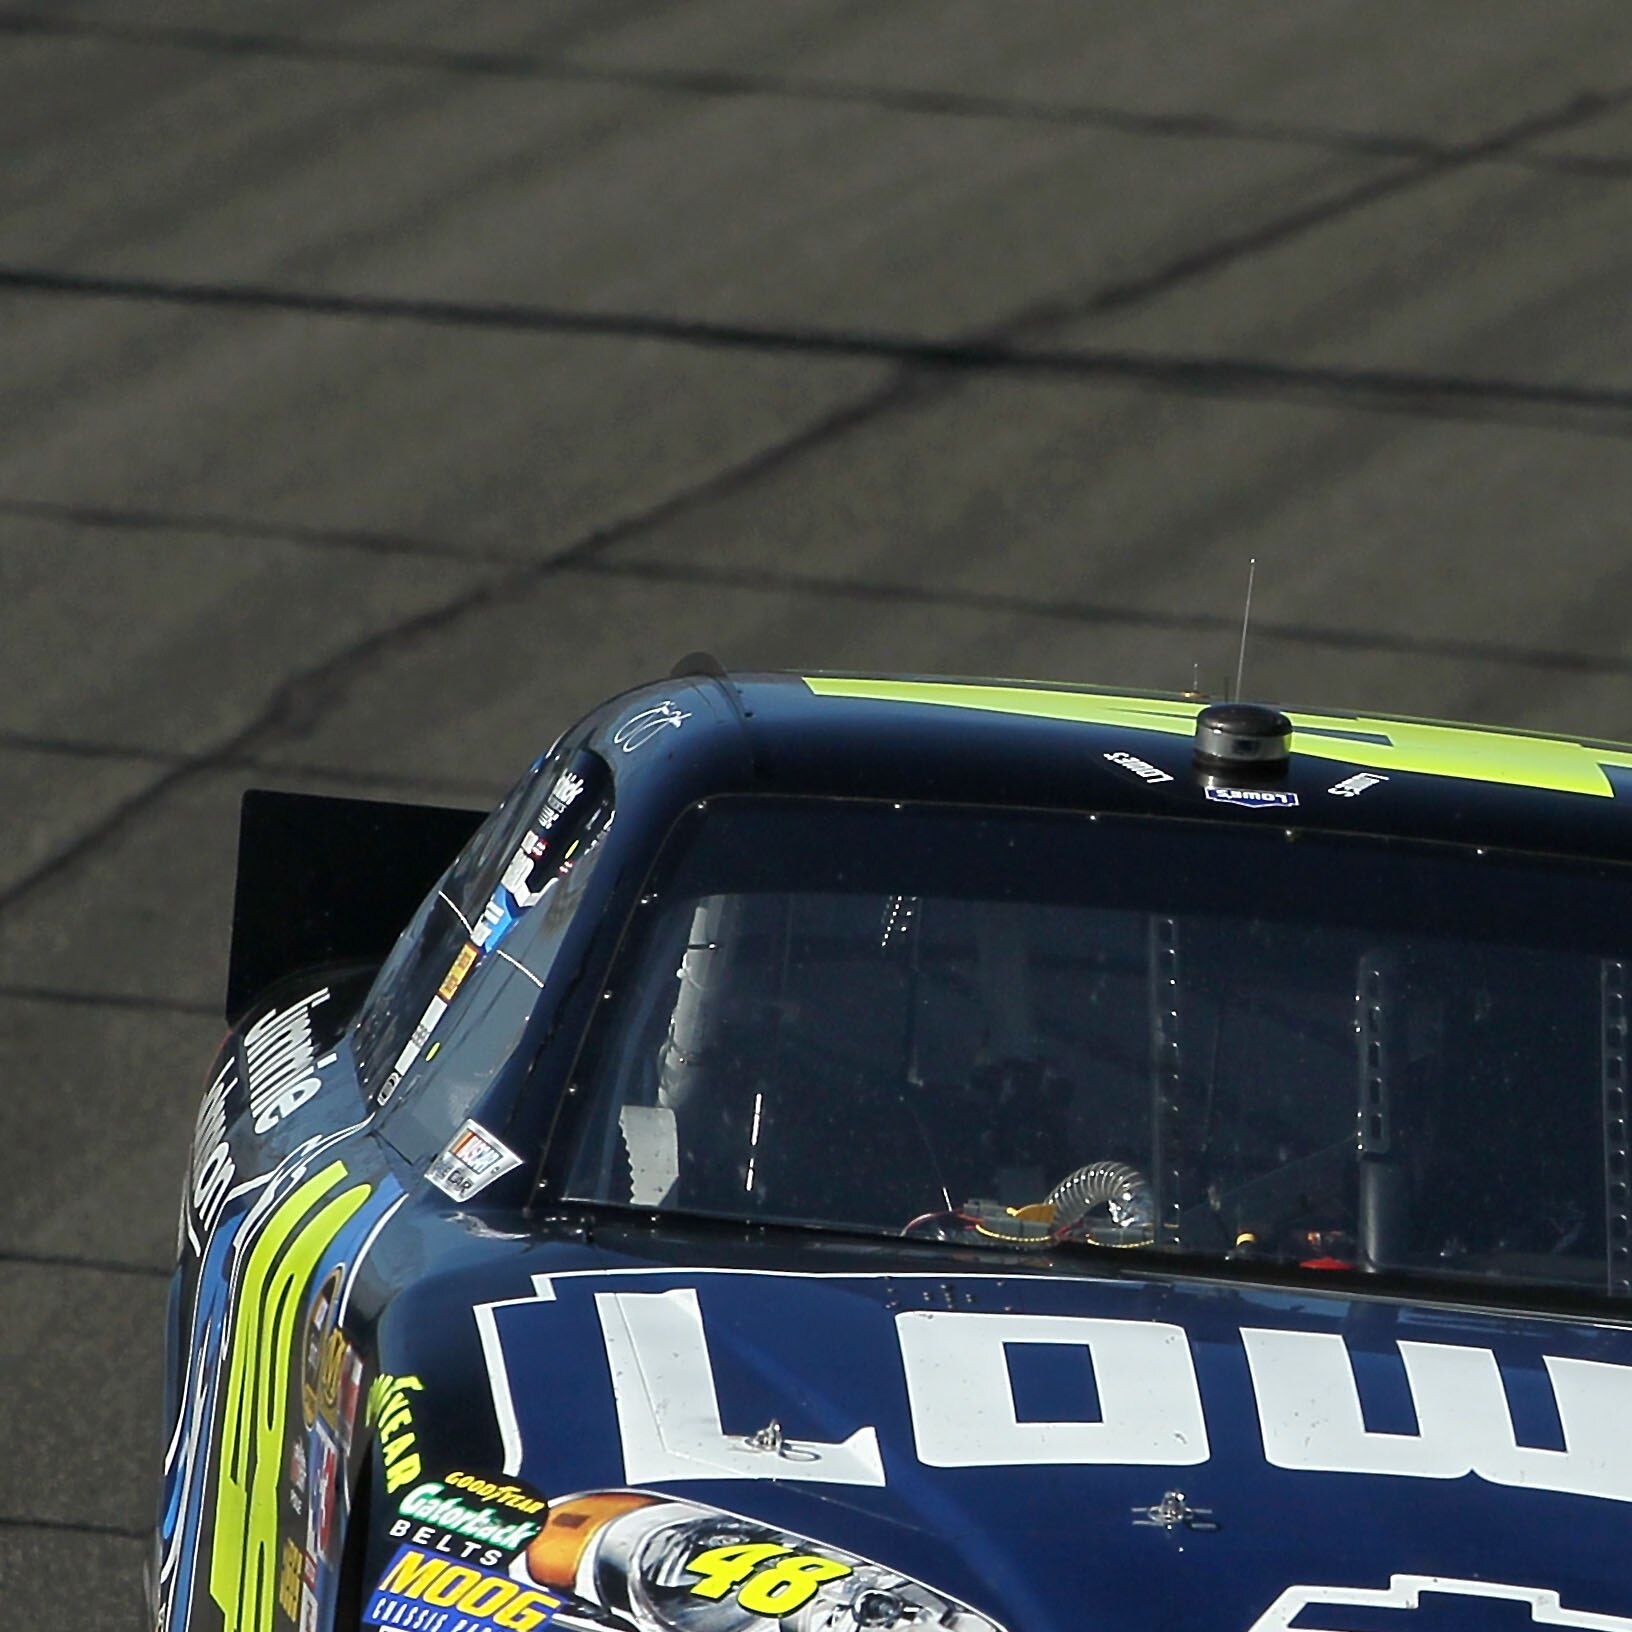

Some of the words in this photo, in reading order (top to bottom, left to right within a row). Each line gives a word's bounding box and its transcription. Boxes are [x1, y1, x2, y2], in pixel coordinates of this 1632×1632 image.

[244, 987, 338, 1134] Jimmie
[389, 1519, 503, 1566] BELTS
[398, 1482, 543, 1550] Gatorback
[686, 1543, 854, 1616] 48
